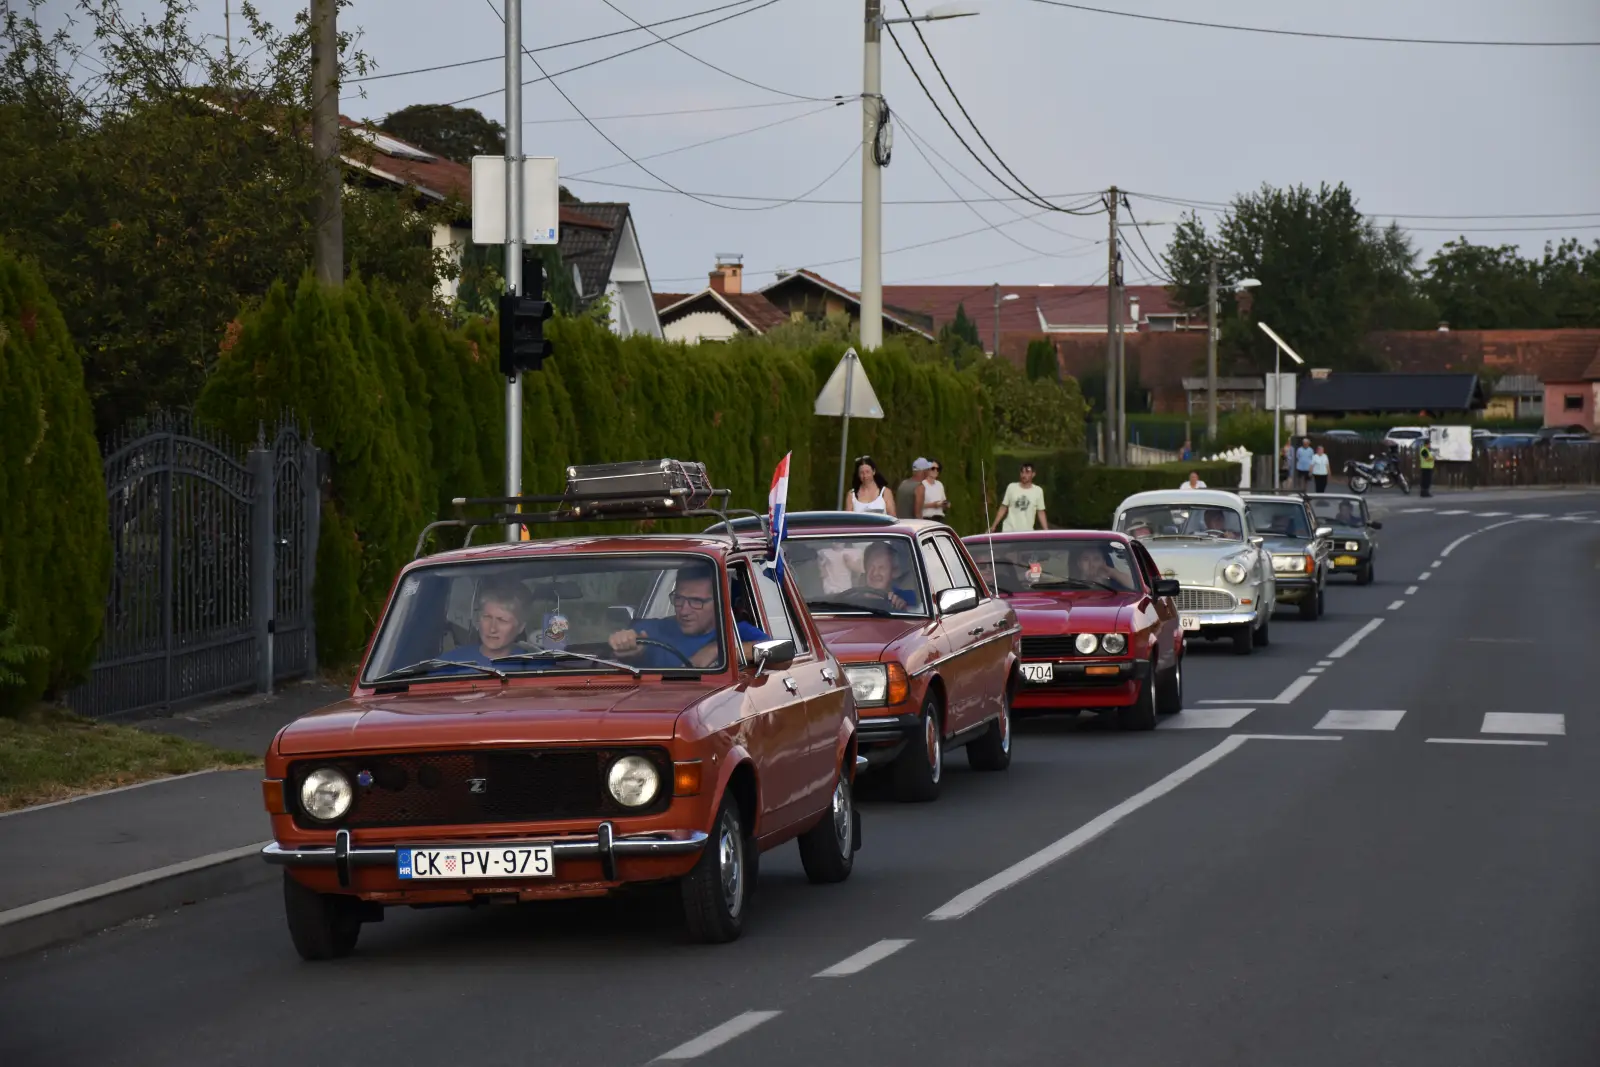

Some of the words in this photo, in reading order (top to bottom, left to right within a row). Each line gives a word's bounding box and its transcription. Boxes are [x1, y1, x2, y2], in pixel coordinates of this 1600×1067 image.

[1022, 666, 1052, 680] 1704
[414, 851, 442, 876] ČK
[461, 849, 549, 875] PV-975
[399, 867, 411, 875] HR
